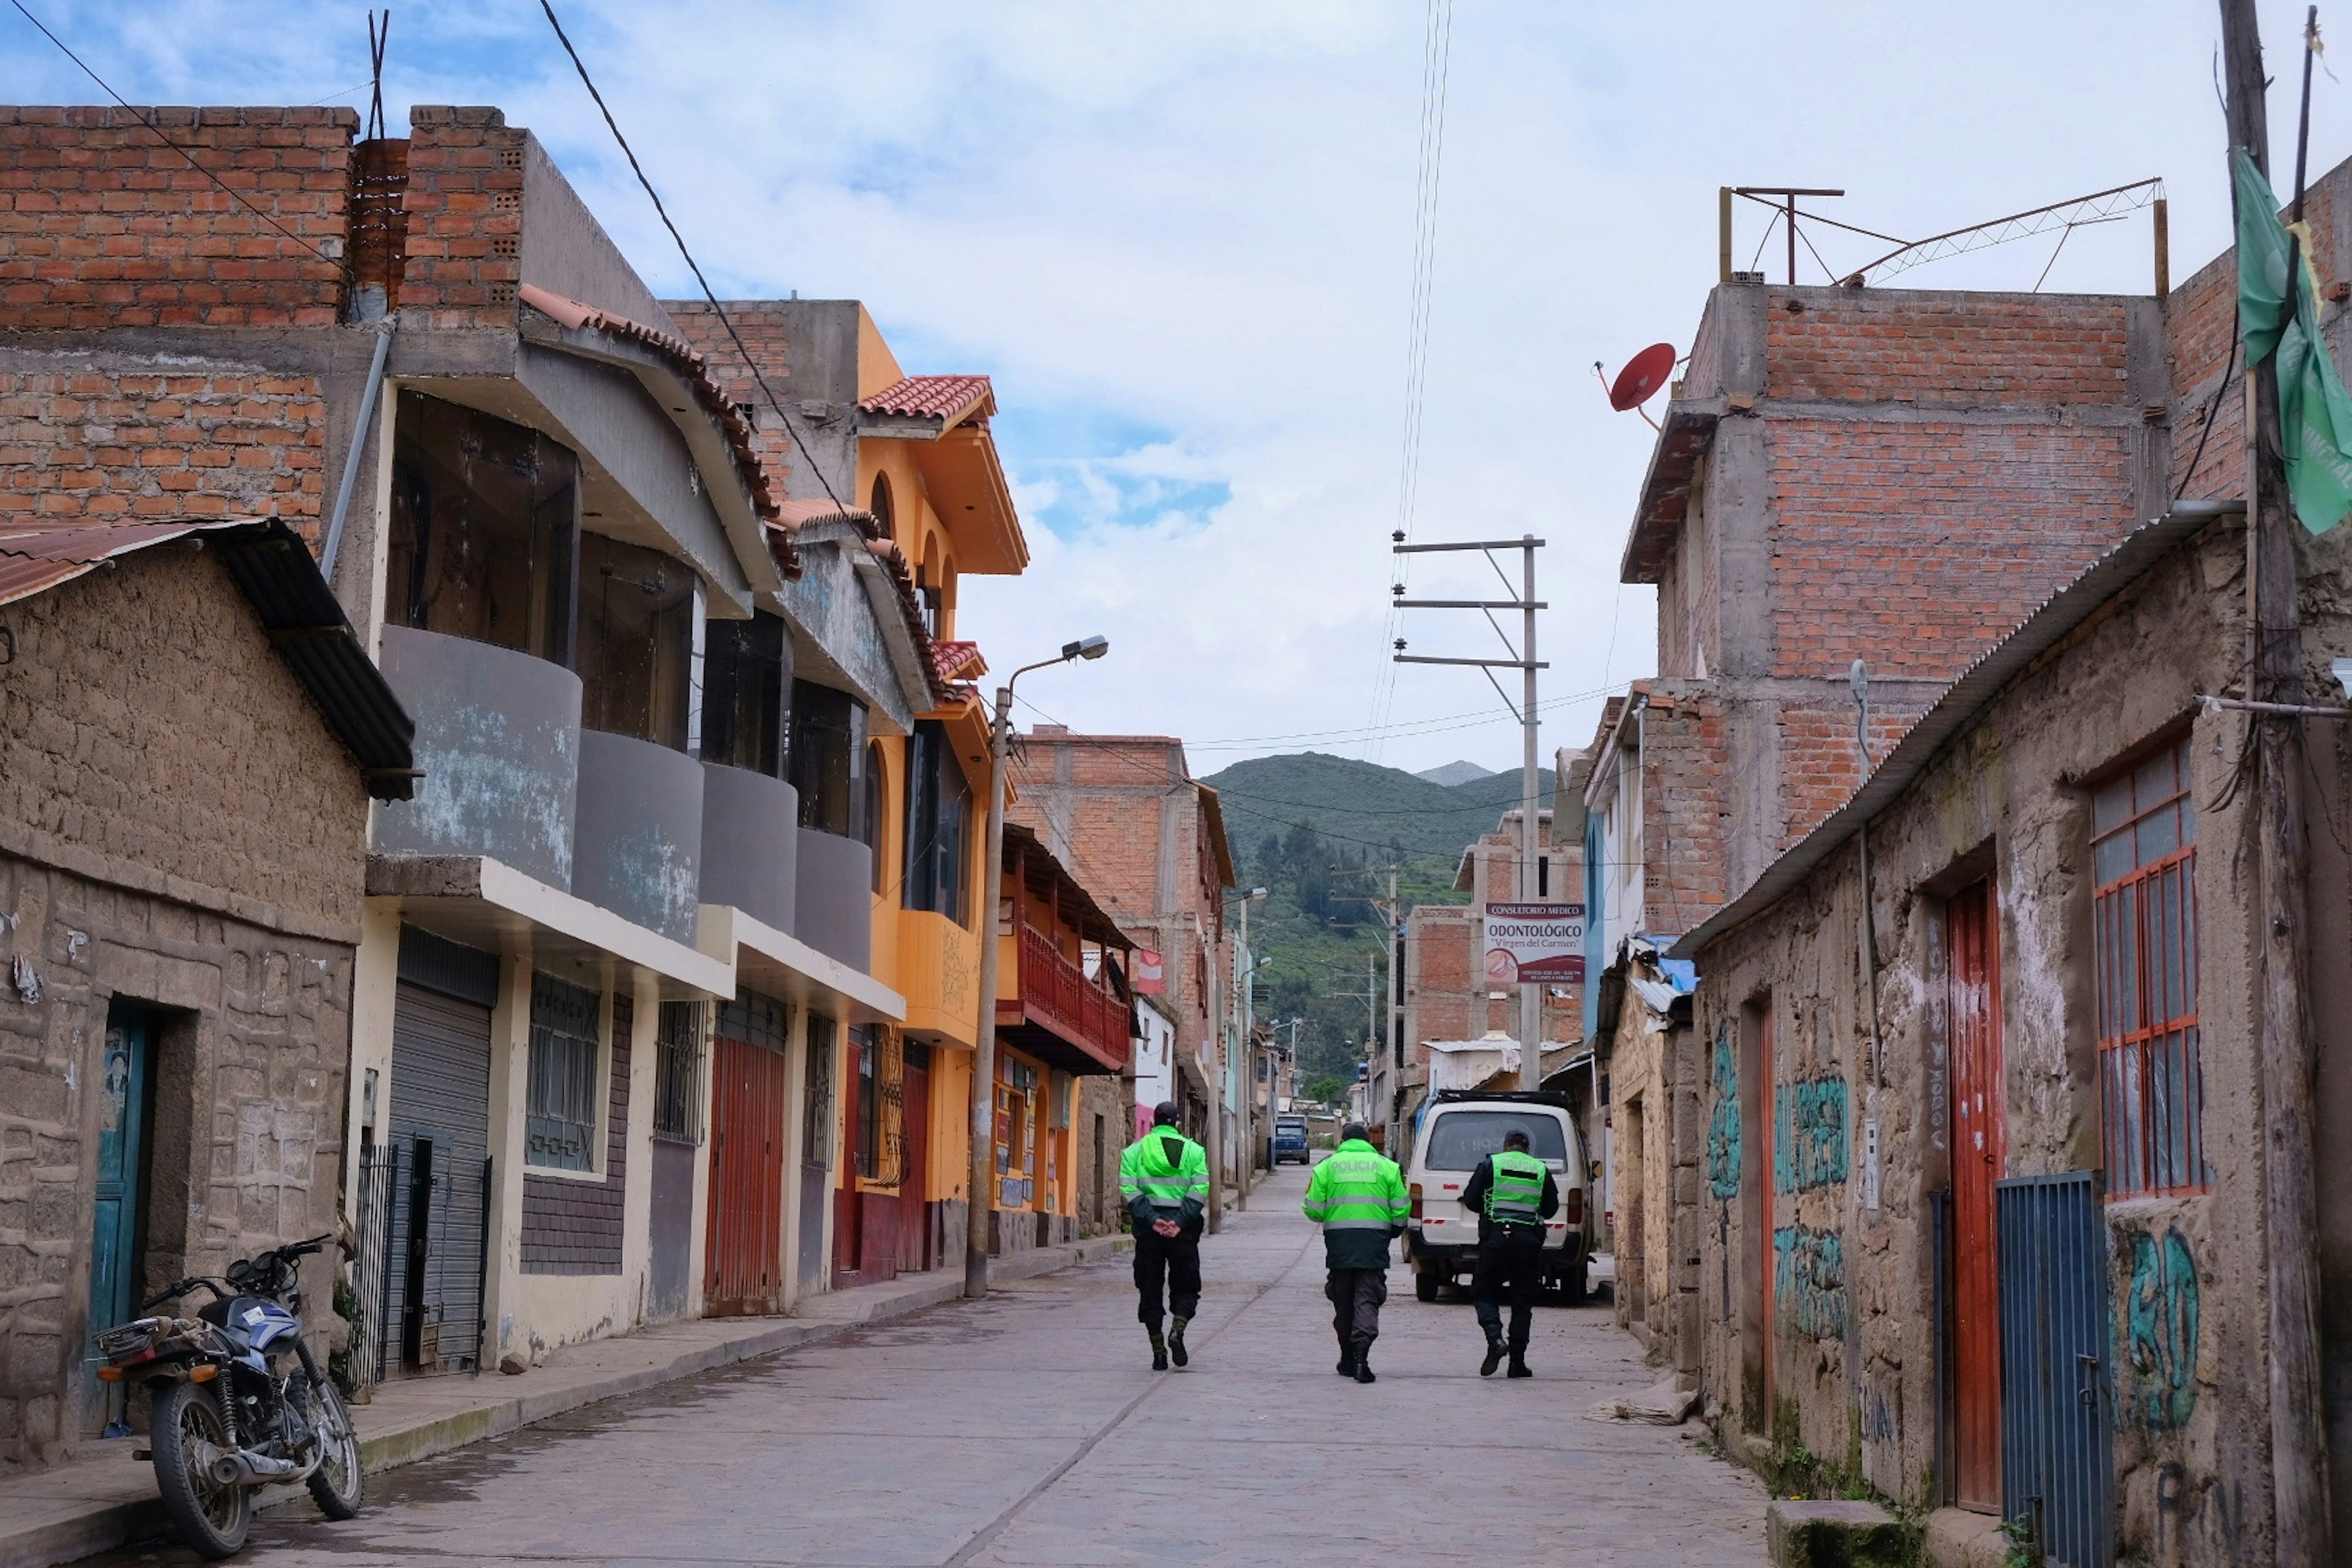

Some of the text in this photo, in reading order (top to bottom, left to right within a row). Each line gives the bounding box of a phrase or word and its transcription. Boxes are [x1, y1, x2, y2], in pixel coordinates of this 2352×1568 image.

[1489, 922, 1581, 937] ODONTOLÓGICO
[1526, 938, 1539, 948] del
[1332, 1159, 1379, 1173] POLICIA
